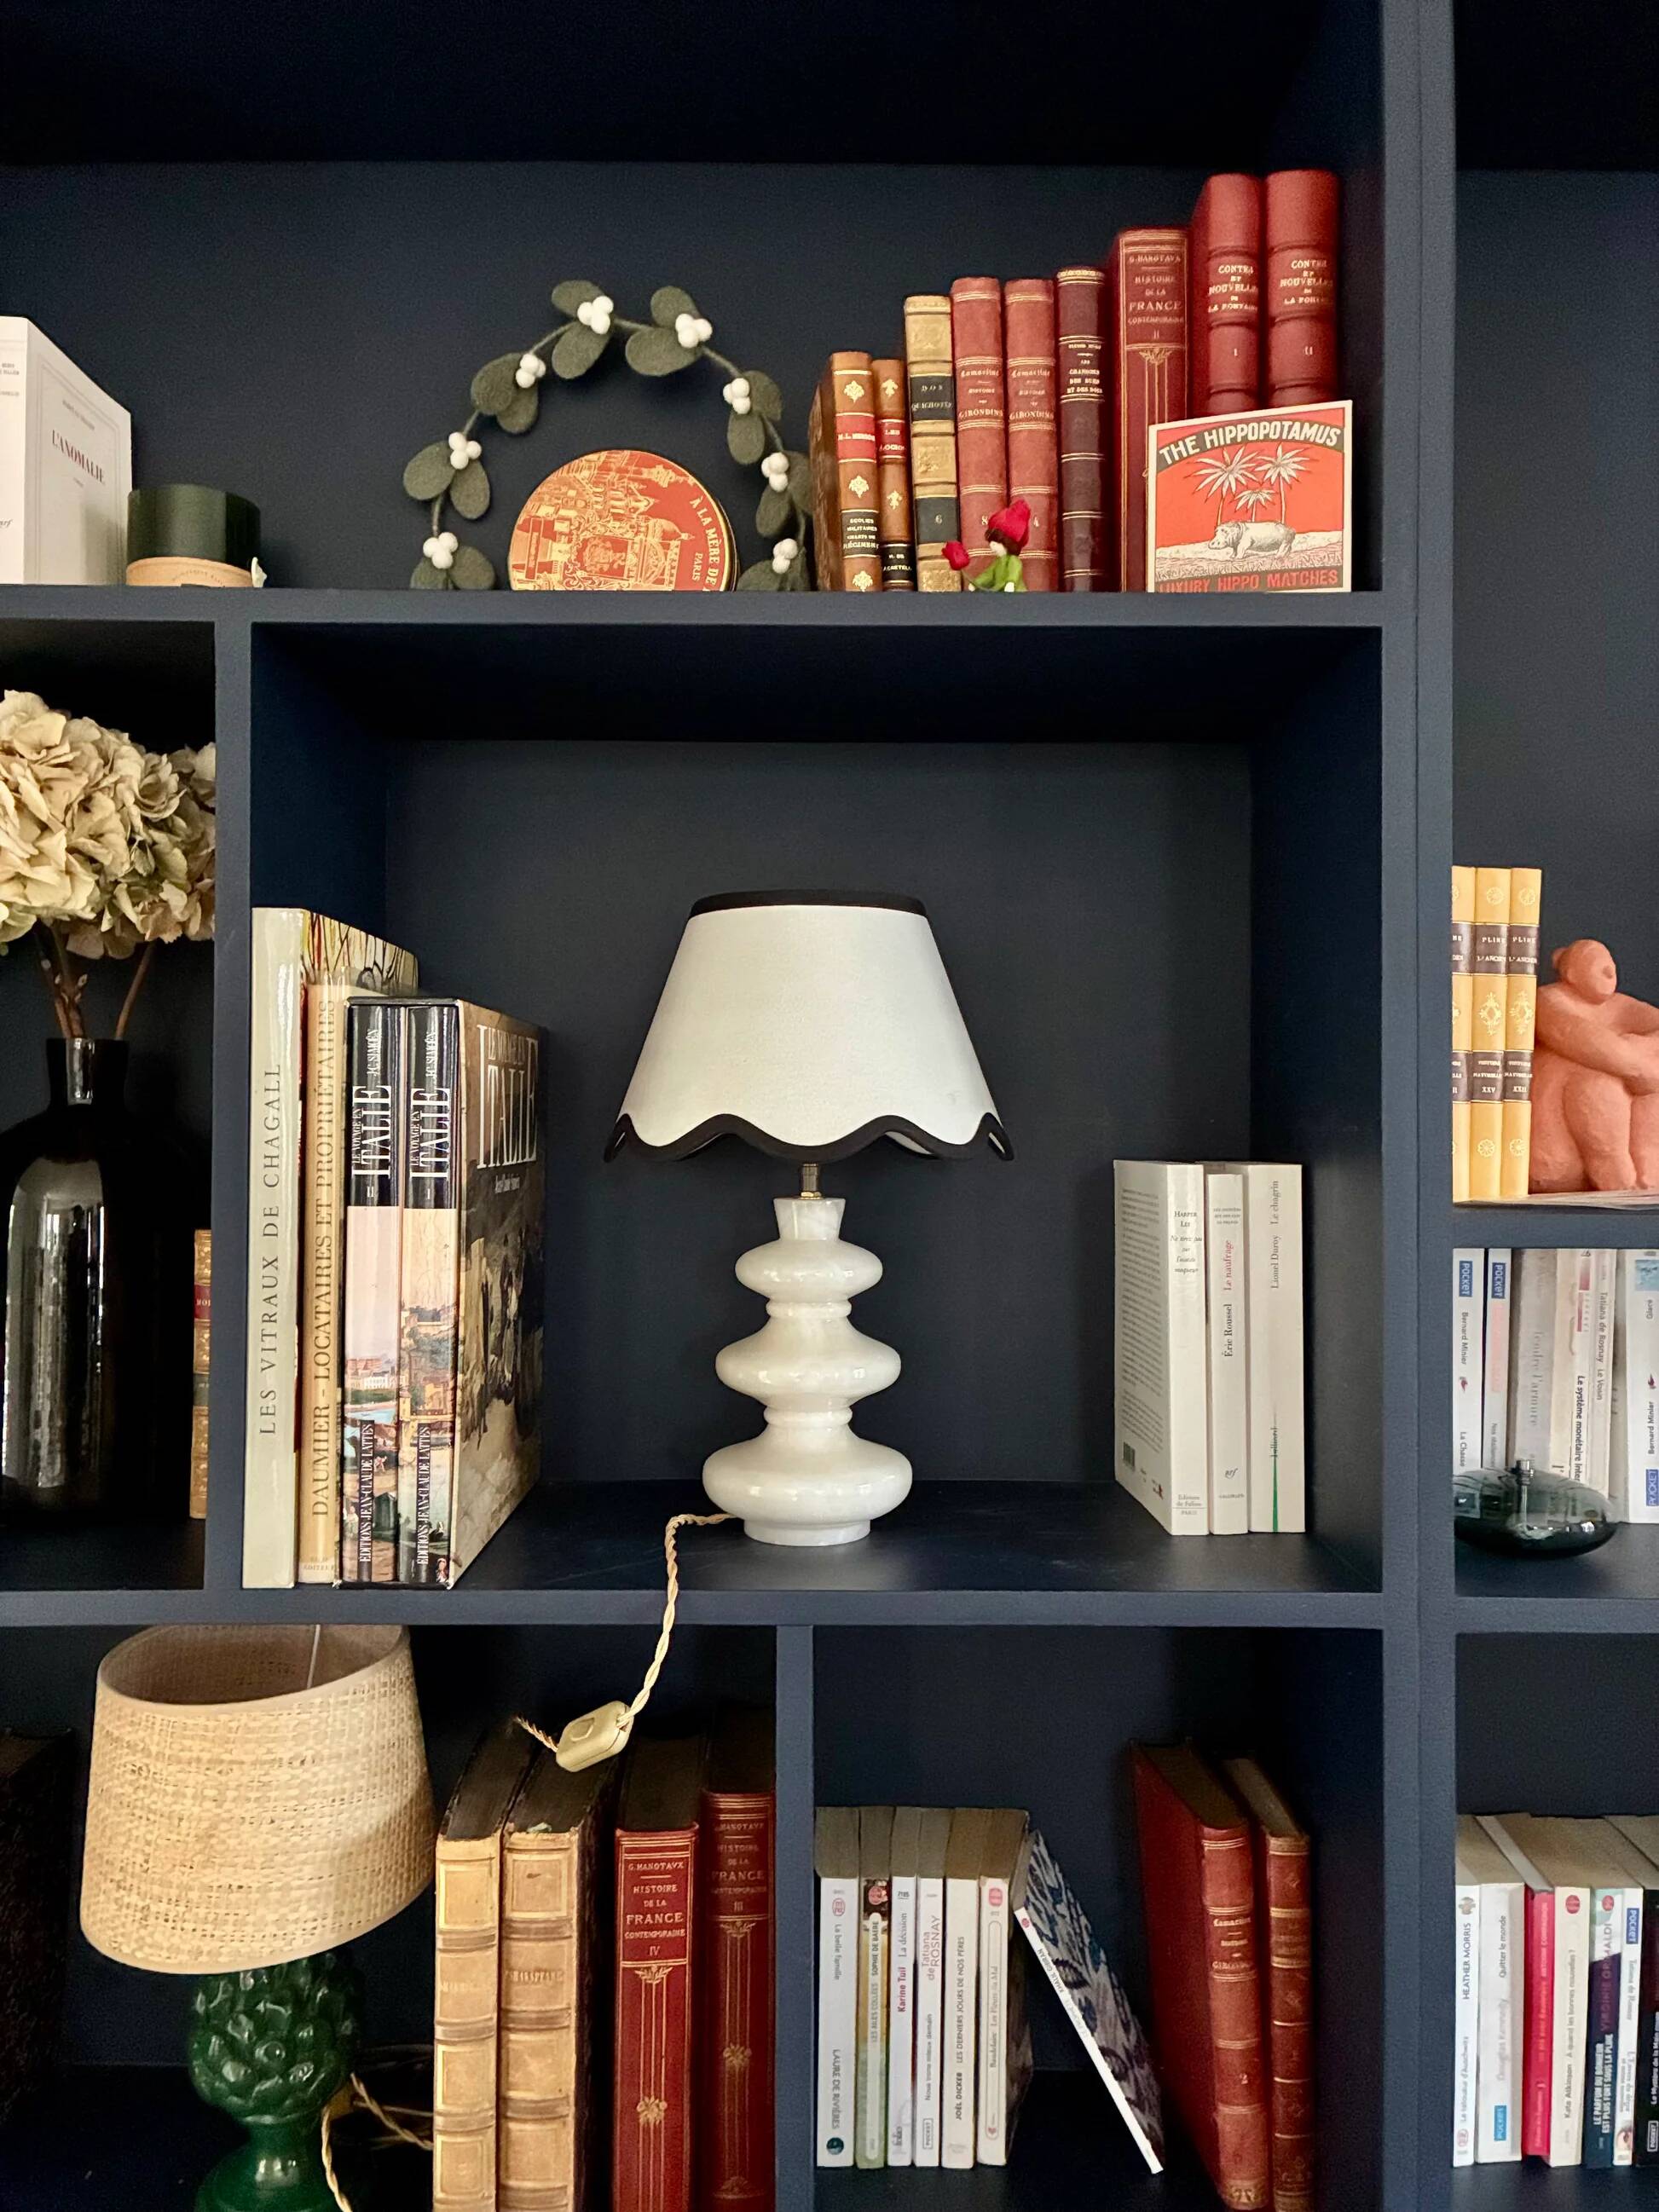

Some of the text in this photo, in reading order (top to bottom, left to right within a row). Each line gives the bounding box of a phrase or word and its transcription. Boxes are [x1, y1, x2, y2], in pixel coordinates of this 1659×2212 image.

[1130, 301, 1182, 312] FRANCE
[1159, 421, 1341, 465] THE HIPPOPOTAMUS
[697, 508, 714, 526] LA
[705, 528, 723, 564] MÈRE
[691, 552, 704, 582] PARIS
[705, 568, 720, 586] DE
[1217, 575, 1260, 592] HIPPO
[1268, 569, 1338, 588] MATCHES
[477, 1024, 539, 1170] ITALIE
[351, 1084, 392, 1179] ITALIE
[351, 1107, 362, 1164] LE VOYAGE EN
[409, 1110, 420, 1167] LE VOYAGE EN
[410, 1087, 451, 1181] ITALIE
[1269, 1180, 1282, 1226] Le chagrin
[259, 1064, 282, 1435] LES VITRAUX DE CHAGALL
[312, 999, 337, 1517] DAUMIER LOCATAIRES ET PROPRIÉTAIRES
[1223, 1239, 1235, 1292] Le naufrage
[1270, 1234, 1282, 1289] Lionel Duroy
[1222, 1302, 1234, 1337] Roussel
[1596, 1292, 1610, 1363] Tatiana de Rosnay
[1460, 1311, 1469, 1365] Bernard Minier
[1597, 1369, 1605, 1377] Le
[1575, 1376, 1586, 1461] Le système monétaire
[1459, 1431, 1467, 1467] La Chasse
[1647, 1425, 1656, 1455] Bernard
[359, 1458, 373, 1521] JEAN-CLAUDE
[417, 1461, 431, 1524] JEAN-CLAUDE
[633, 1884, 679, 1894] HISTOIRE
[643, 1898, 668, 1908] DE LA
[624, 1928, 686, 1939] CONTEMPORAINE
[626, 1912, 685, 1926] FRANCE
[898, 1912, 909, 1958] La décision
[1498, 1915, 1507, 1943] monde
[649, 1945, 661, 1957] IV
[834, 1934, 842, 1953] belle
[921, 1932, 930, 1967] Tatiana
[927, 1915, 940, 1981] de ROSNAY
[833, 1955, 842, 1980] famille
[956, 1958, 965, 1976] NOS
[1462, 1923, 1471, 2000] HEATHER MORRIS
[1498, 1951, 1508, 1978] Quitter
[897, 1967, 907, 2013] Karine Tuil
[956, 1977, 964, 1987] DE
[956, 1989, 965, 2013] JOURS
[956, 2014, 964, 2050] DERNIERS
[1605, 2034, 1614, 2054] PLUIE
[956, 2051, 964, 2064] LES
[1604, 2055, 1613, 2064] LA
[1604, 2064, 1612, 2082] SOUS
[831, 2048, 841, 2129] LAURE DE RIVIÈRES
[1565, 2064, 1574, 2099] Atkinson
[1593, 2043, 1604, 2125] LE PARFUM DU BONHEUR
[954, 2101, 963, 2121] JOËL
[1603, 2101, 1611, 2120] PLUS
[1650, 2095, 1658, 2105] Le
[1602, 2121, 1610, 2134] EST
